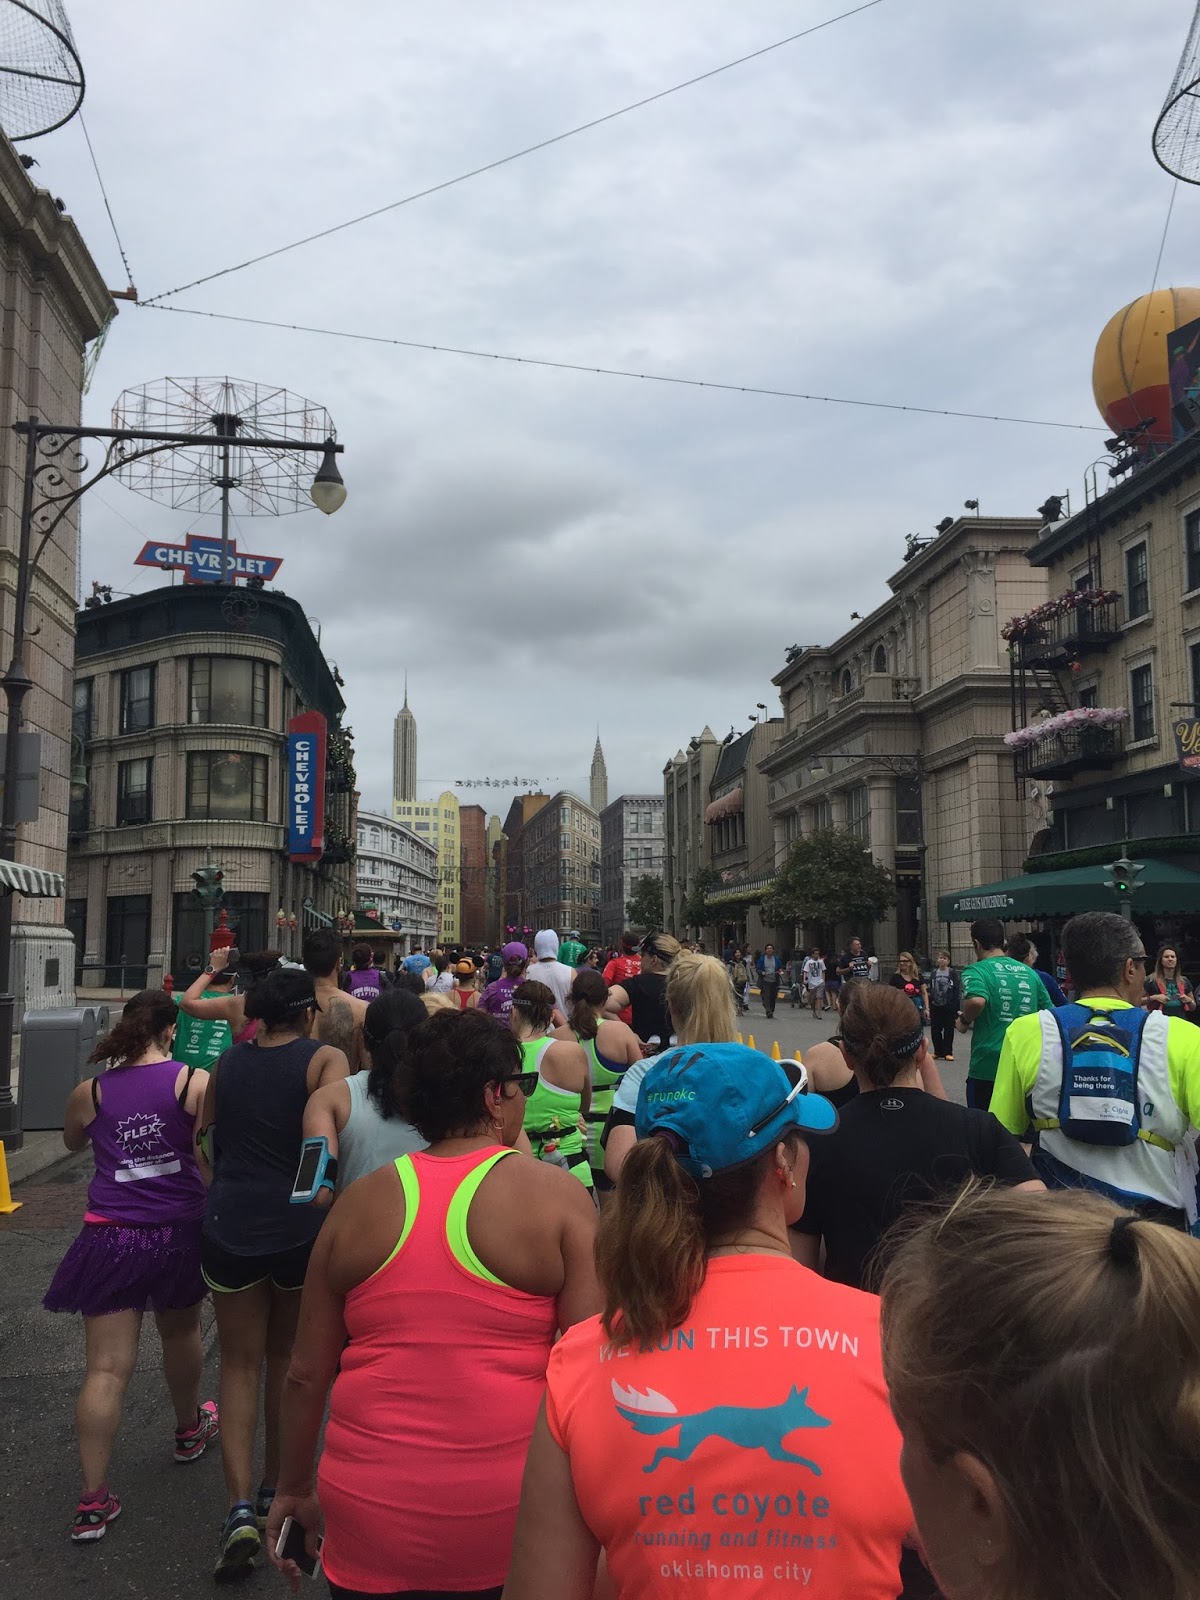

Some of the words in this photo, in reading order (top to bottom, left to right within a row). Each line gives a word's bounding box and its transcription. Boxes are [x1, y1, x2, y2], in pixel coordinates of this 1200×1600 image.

[155, 547, 266, 574] CHEVROLET
[294, 741, 310, 835] CHEVROLET
[1005, 964, 1027, 972] Cigna
[1073, 1081, 1094, 1089] being
[1111, 1105, 1128, 1115] Cigna
[123, 1123, 157, 1141] FLEX
[147, 1151, 174, 1160] distance
[706, 1326, 769, 1349] THIS
[779, 1326, 859, 1358] TOWN
[639, 1485, 695, 1517] red
[712, 1489, 831, 1523] coyote
[633, 1529, 711, 1551] running
[719, 1529, 758, 1547] and
[766, 1529, 838, 1550] fitness
[660, 1559, 764, 1579] oklahoma
[773, 1560, 813, 1586] city
